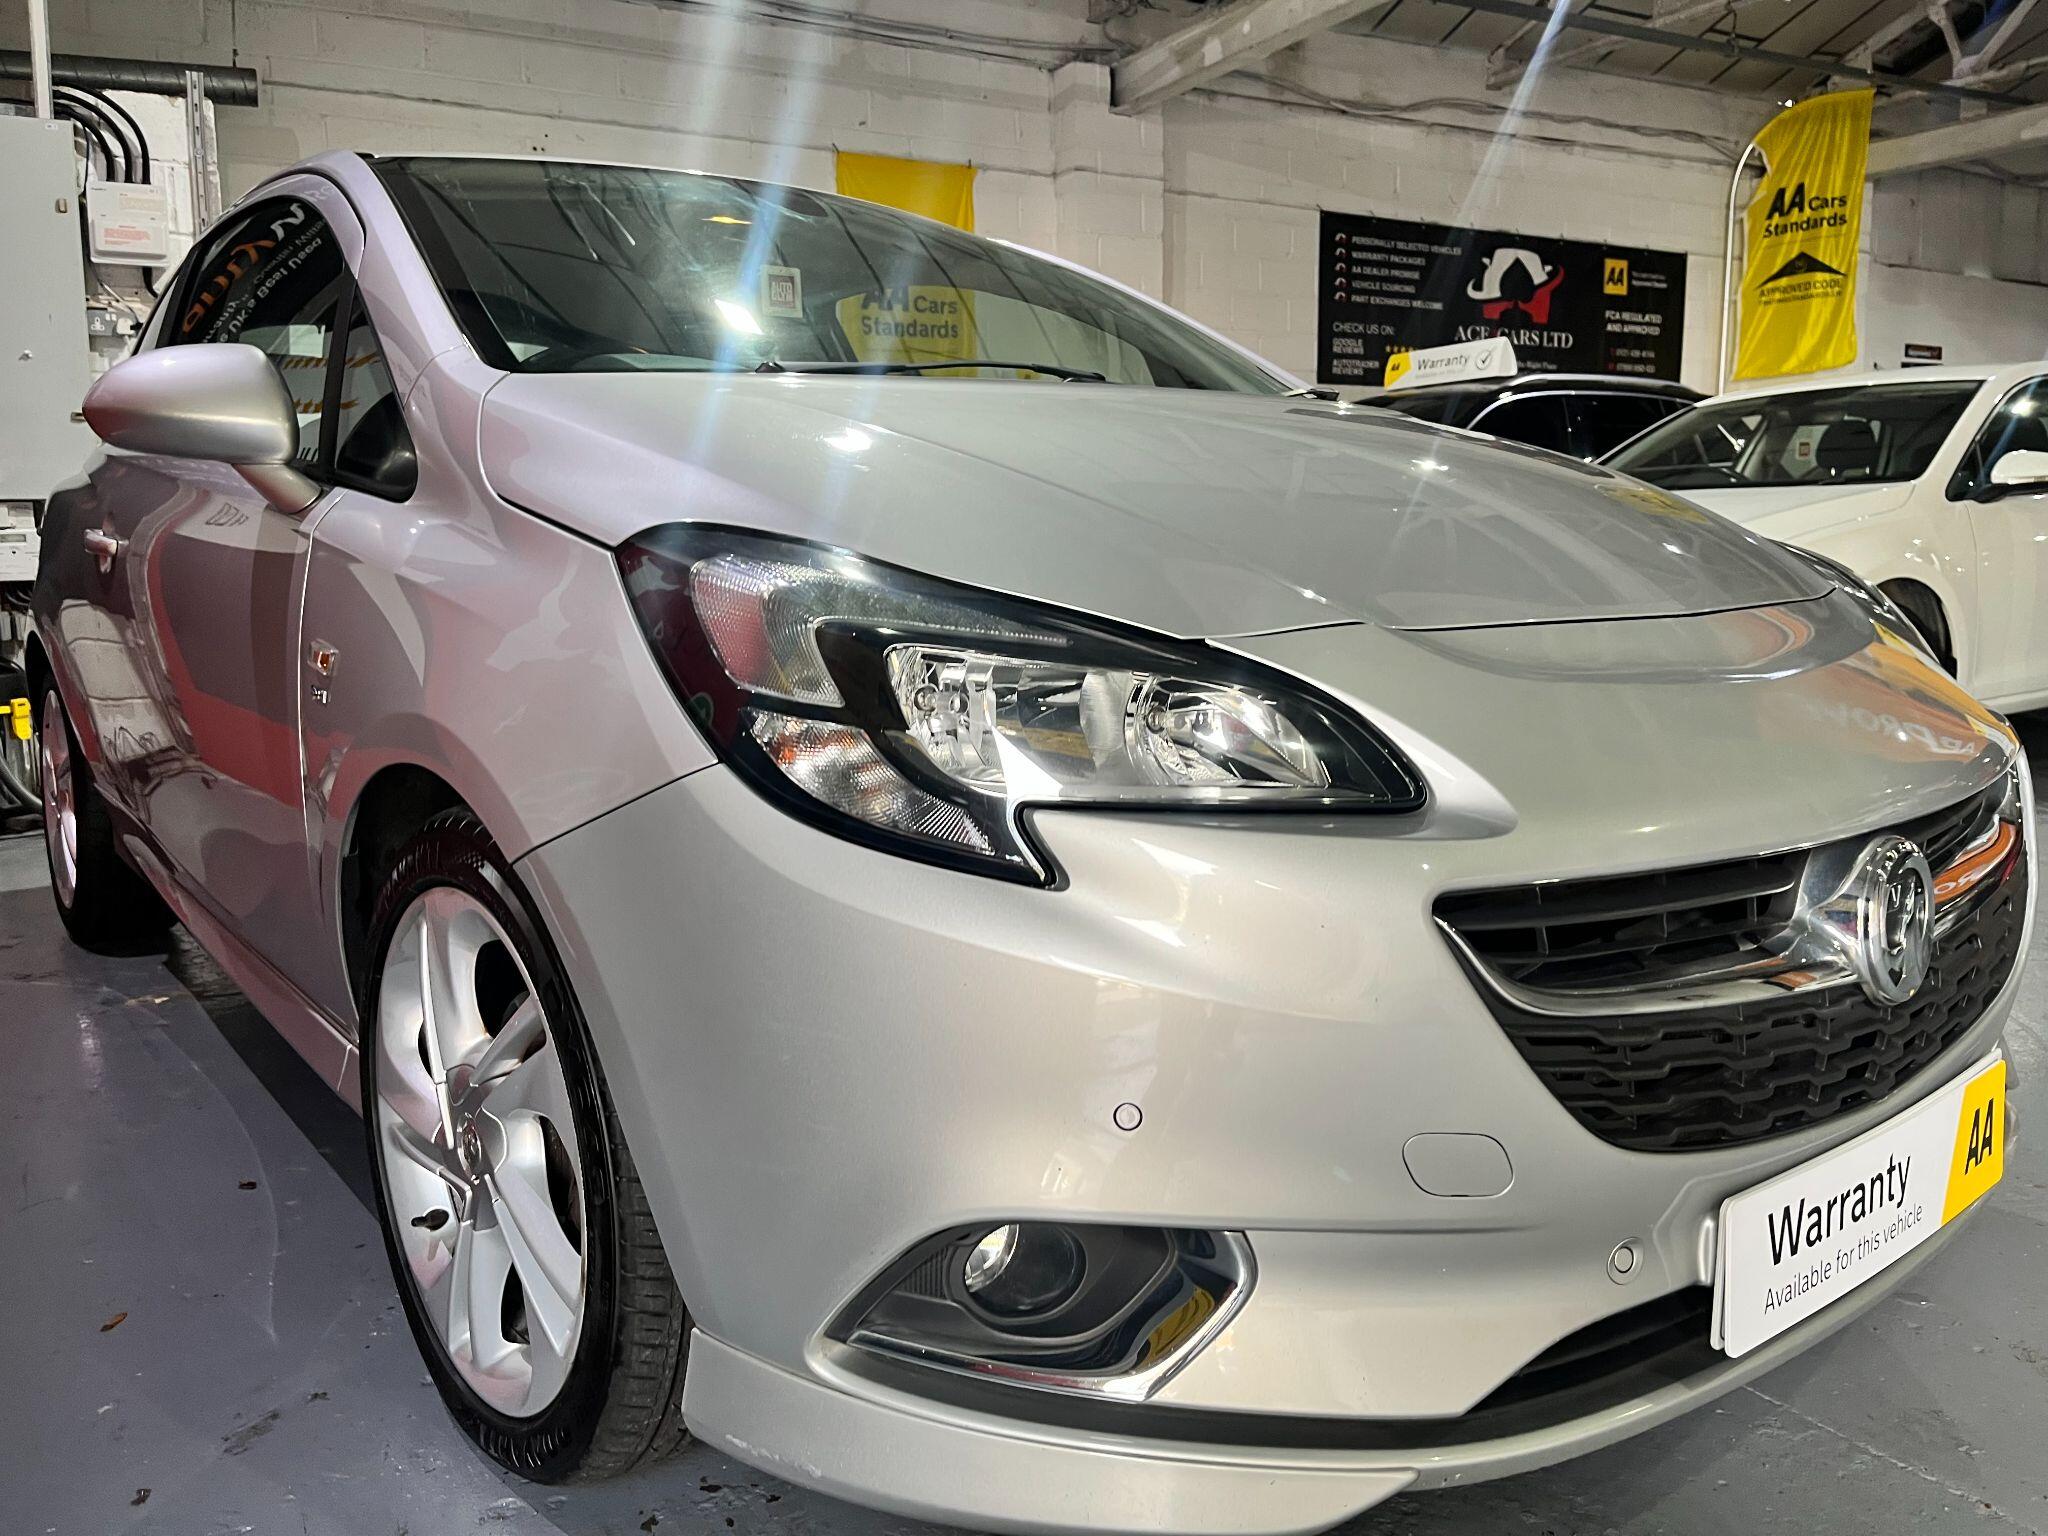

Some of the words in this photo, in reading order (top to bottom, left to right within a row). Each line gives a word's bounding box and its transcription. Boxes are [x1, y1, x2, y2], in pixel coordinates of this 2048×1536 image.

[1766, 182, 1805, 220] AA
[1808, 195, 1847, 212] Cars
[1763, 212, 1847, 239] Standards
[1606, 267, 1624, 287] AA
[861, 285, 909, 313] AA
[914, 296, 957, 315] Cars
[862, 316, 958, 339] Standards
[1605, 310, 1621, 320] FCA
[1333, 322, 1364, 333] CHECK
[1366, 324, 1379, 334] US
[1454, 325, 1490, 342] ACE
[1497, 328, 1539, 346] CARS
[1543, 331, 1573, 348] LTD
[1418, 354, 1469, 371] Warranty
[1964, 1097, 1994, 1176] AA
[1767, 1152, 1912, 1266] Warranty
[1764, 1261, 1832, 1315] Available
[1836, 1247, 1855, 1274] for
[1858, 1230, 1880, 1261] this
[1883, 1202, 1923, 1245] vehicle
